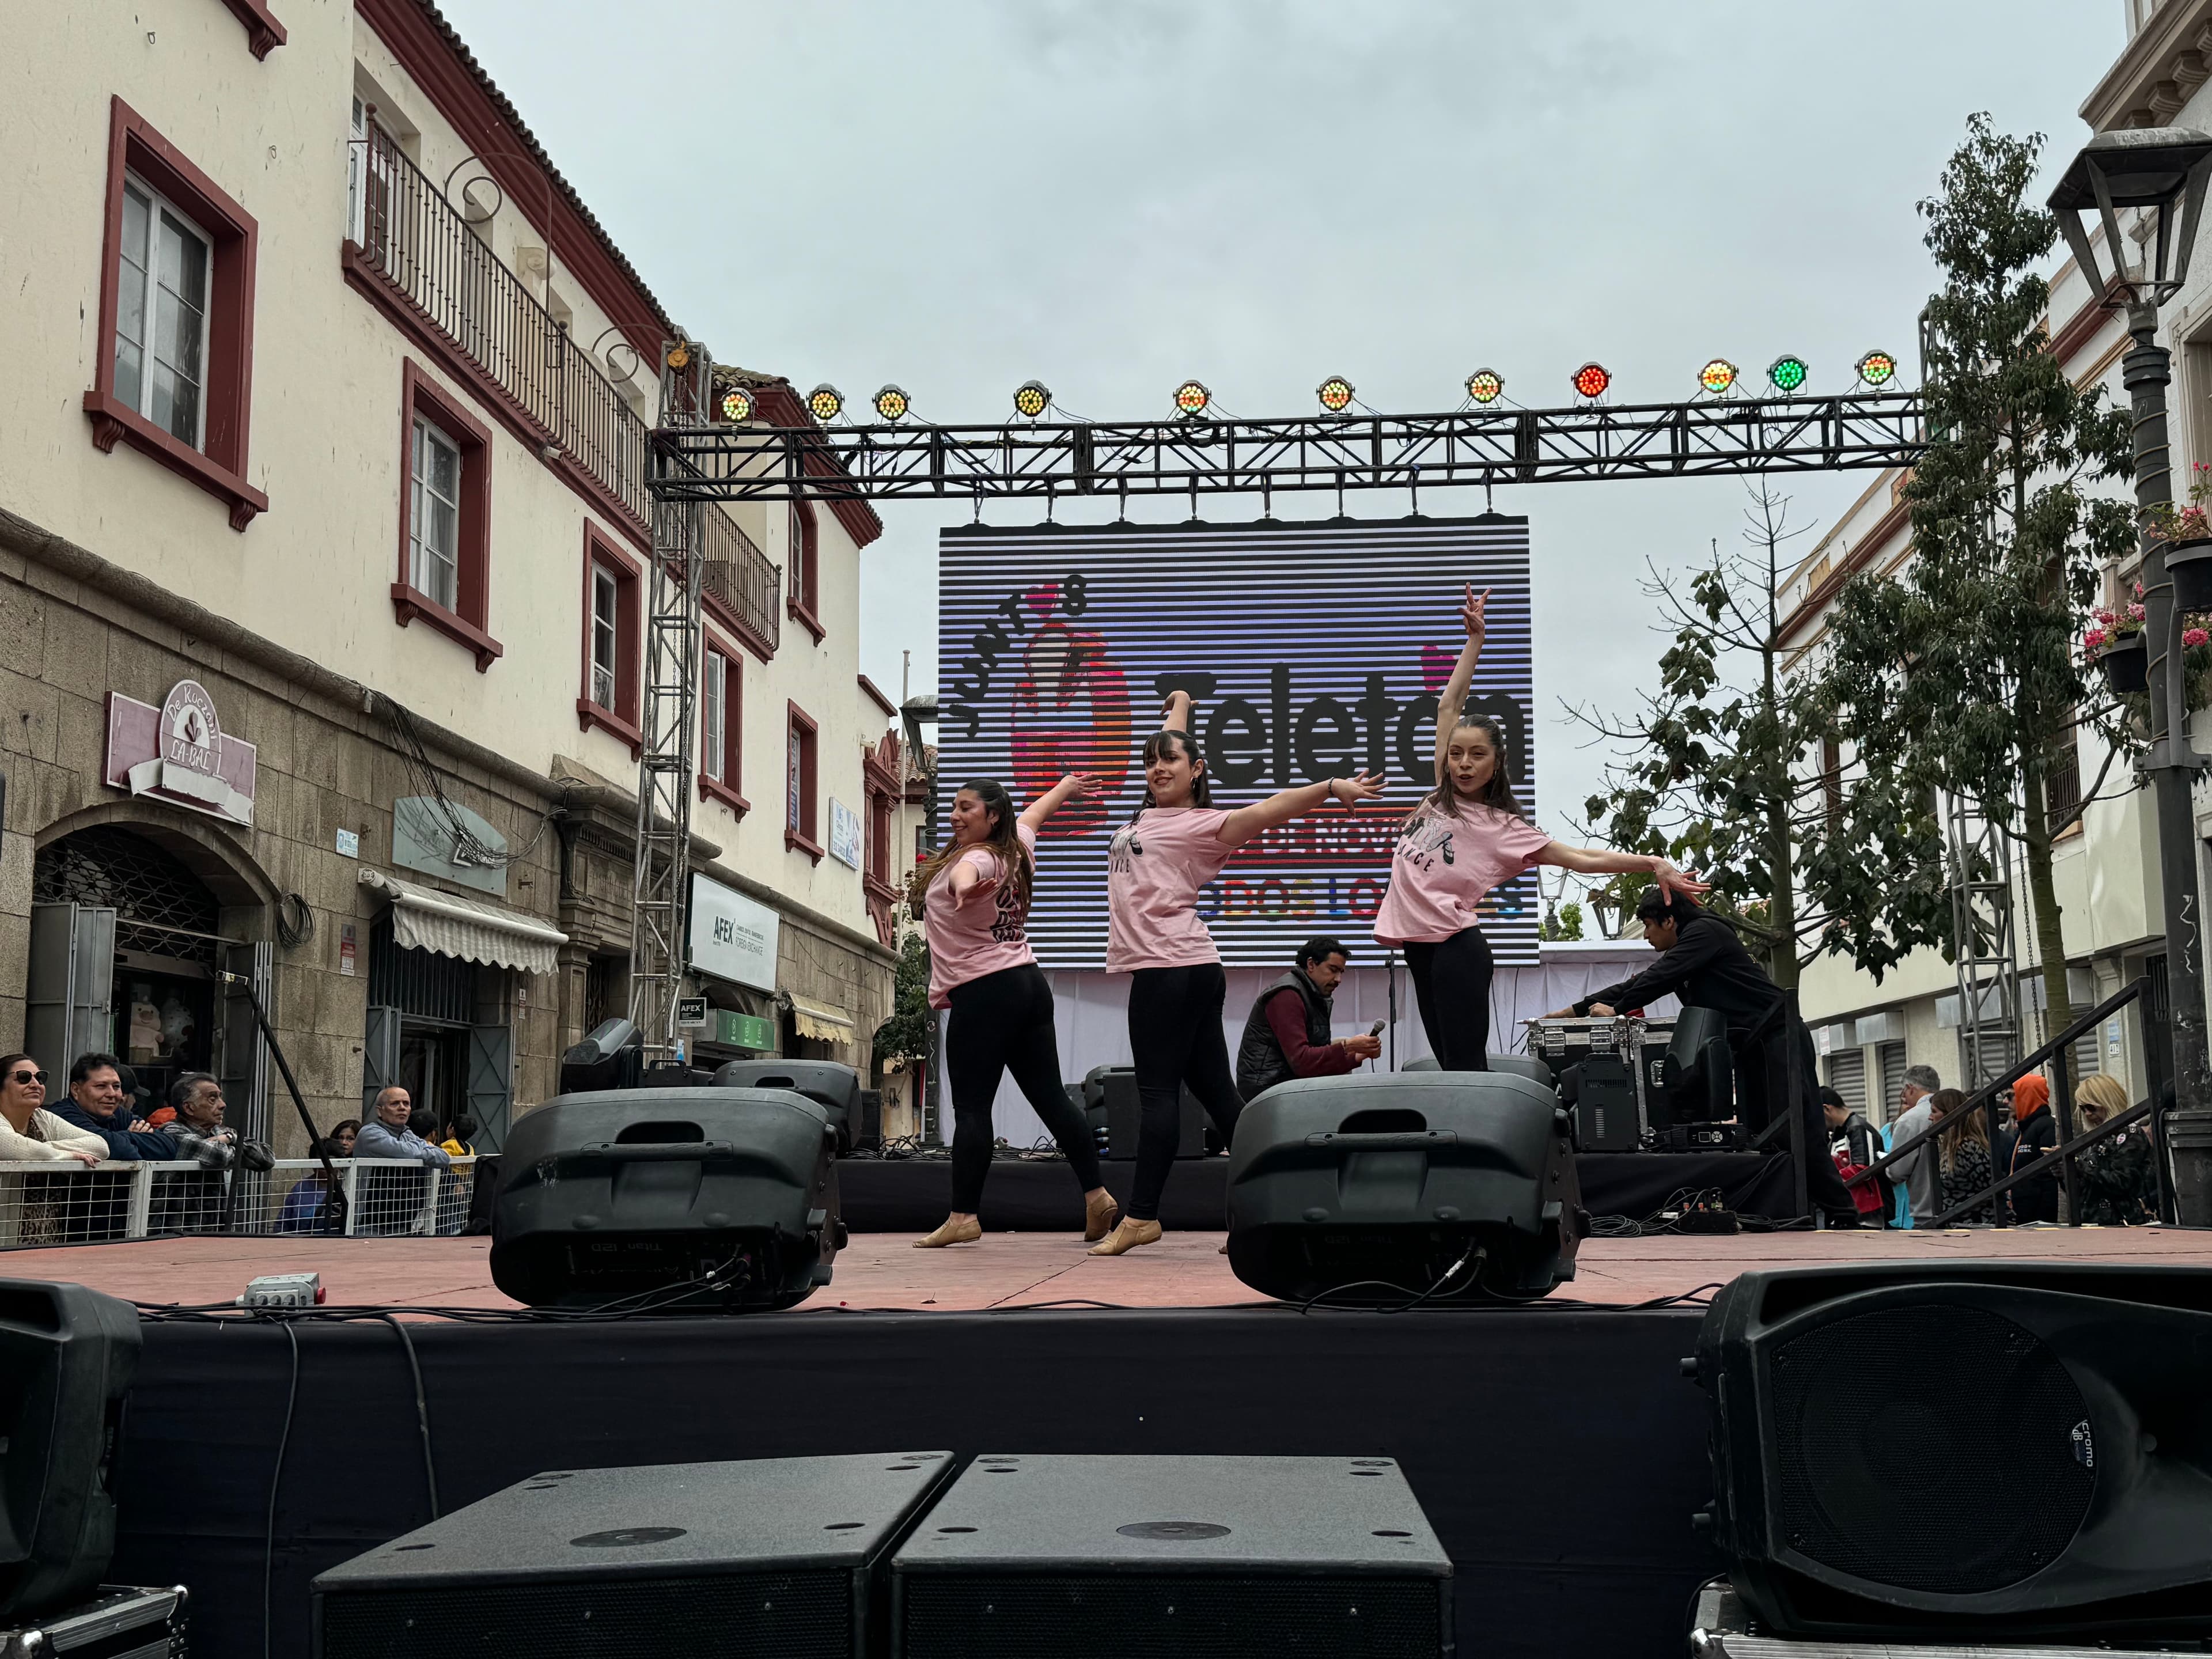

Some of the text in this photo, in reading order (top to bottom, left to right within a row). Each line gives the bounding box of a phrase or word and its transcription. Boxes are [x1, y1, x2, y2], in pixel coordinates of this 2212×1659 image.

[166, 700, 181, 722] De
[714, 915, 734, 945] AFEX
[680, 1004, 701, 1013] AFEX
[627, 1242, 664, 1252] Titan
[2072, 1429, 2084, 1441] dB
[2082, 1422, 2093, 1467] cromo
